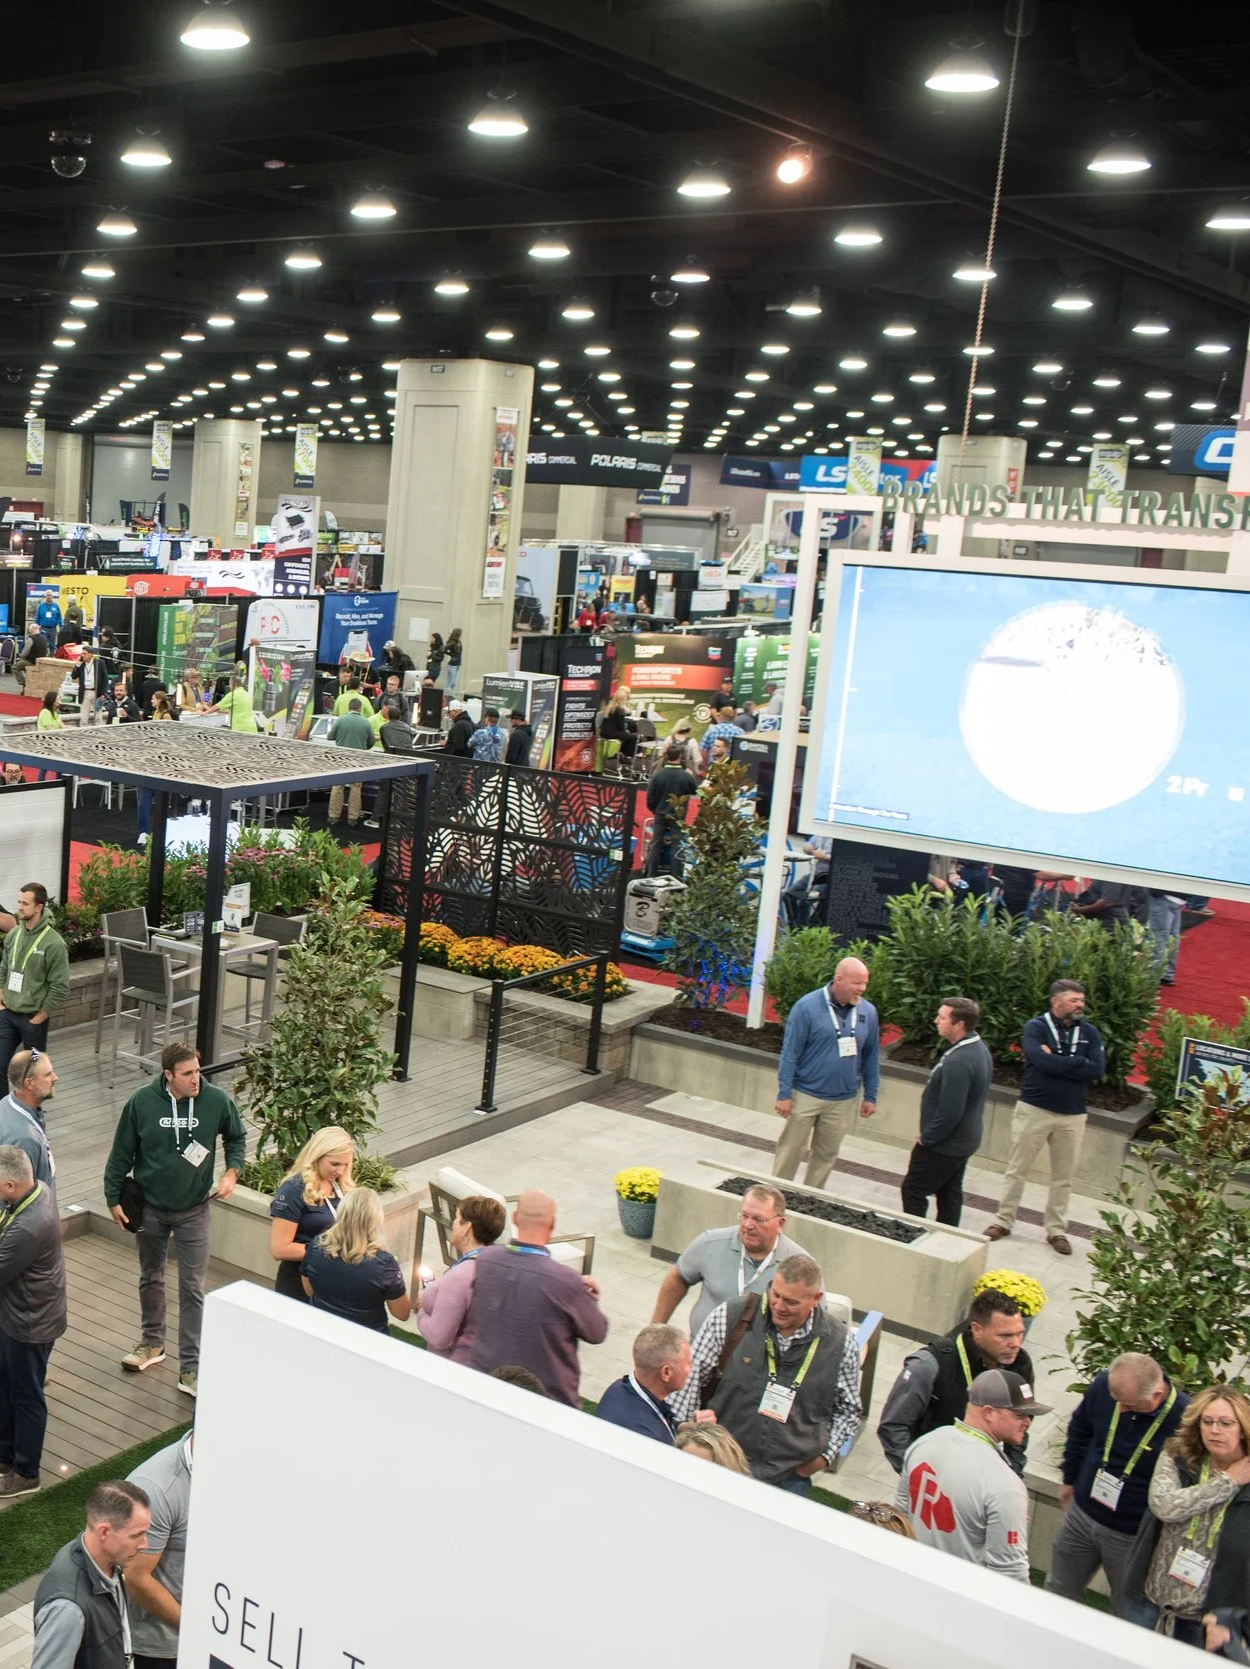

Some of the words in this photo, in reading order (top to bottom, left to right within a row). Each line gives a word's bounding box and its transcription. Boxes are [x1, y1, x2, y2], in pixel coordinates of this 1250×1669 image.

[590, 454, 638, 470] POLARIS
[882, 481, 1011, 518] BRANDS
[1020, 485, 1105, 523] THAT
[567, 665, 602, 675] TECHRON
